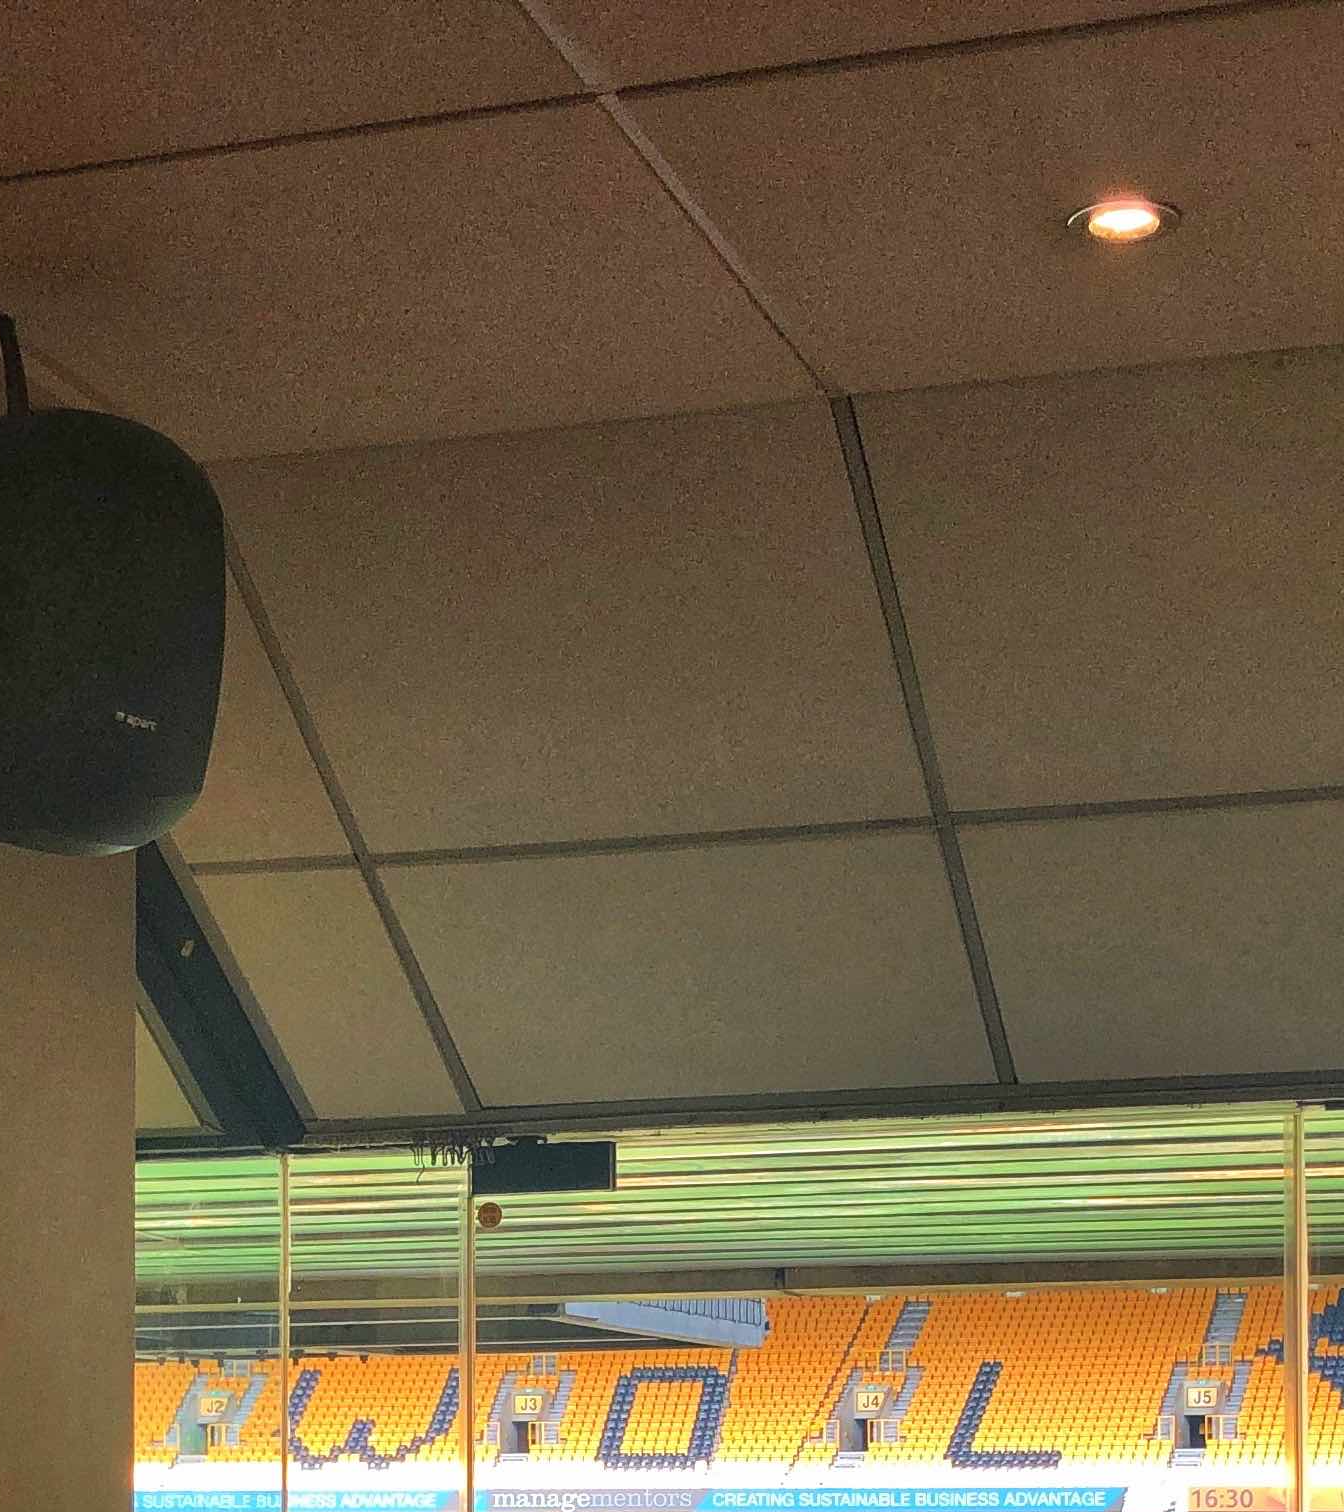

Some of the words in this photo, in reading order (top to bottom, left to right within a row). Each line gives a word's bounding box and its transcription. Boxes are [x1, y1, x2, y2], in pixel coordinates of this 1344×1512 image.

[863, 1393, 880, 1409] J4
[1194, 1388, 1212, 1405] J5
[521, 1398, 538, 1412] J3
[493, 1489, 692, 1512] managementors
[712, 1493, 795, 1508] CREATING
[799, 1493, 911, 1508] SUSTAINABLE
[915, 1493, 999, 1507] BUSINESS
[1004, 1492, 1105, 1507] ADVANTAGE
[1191, 1488, 1253, 1508] 16:30
